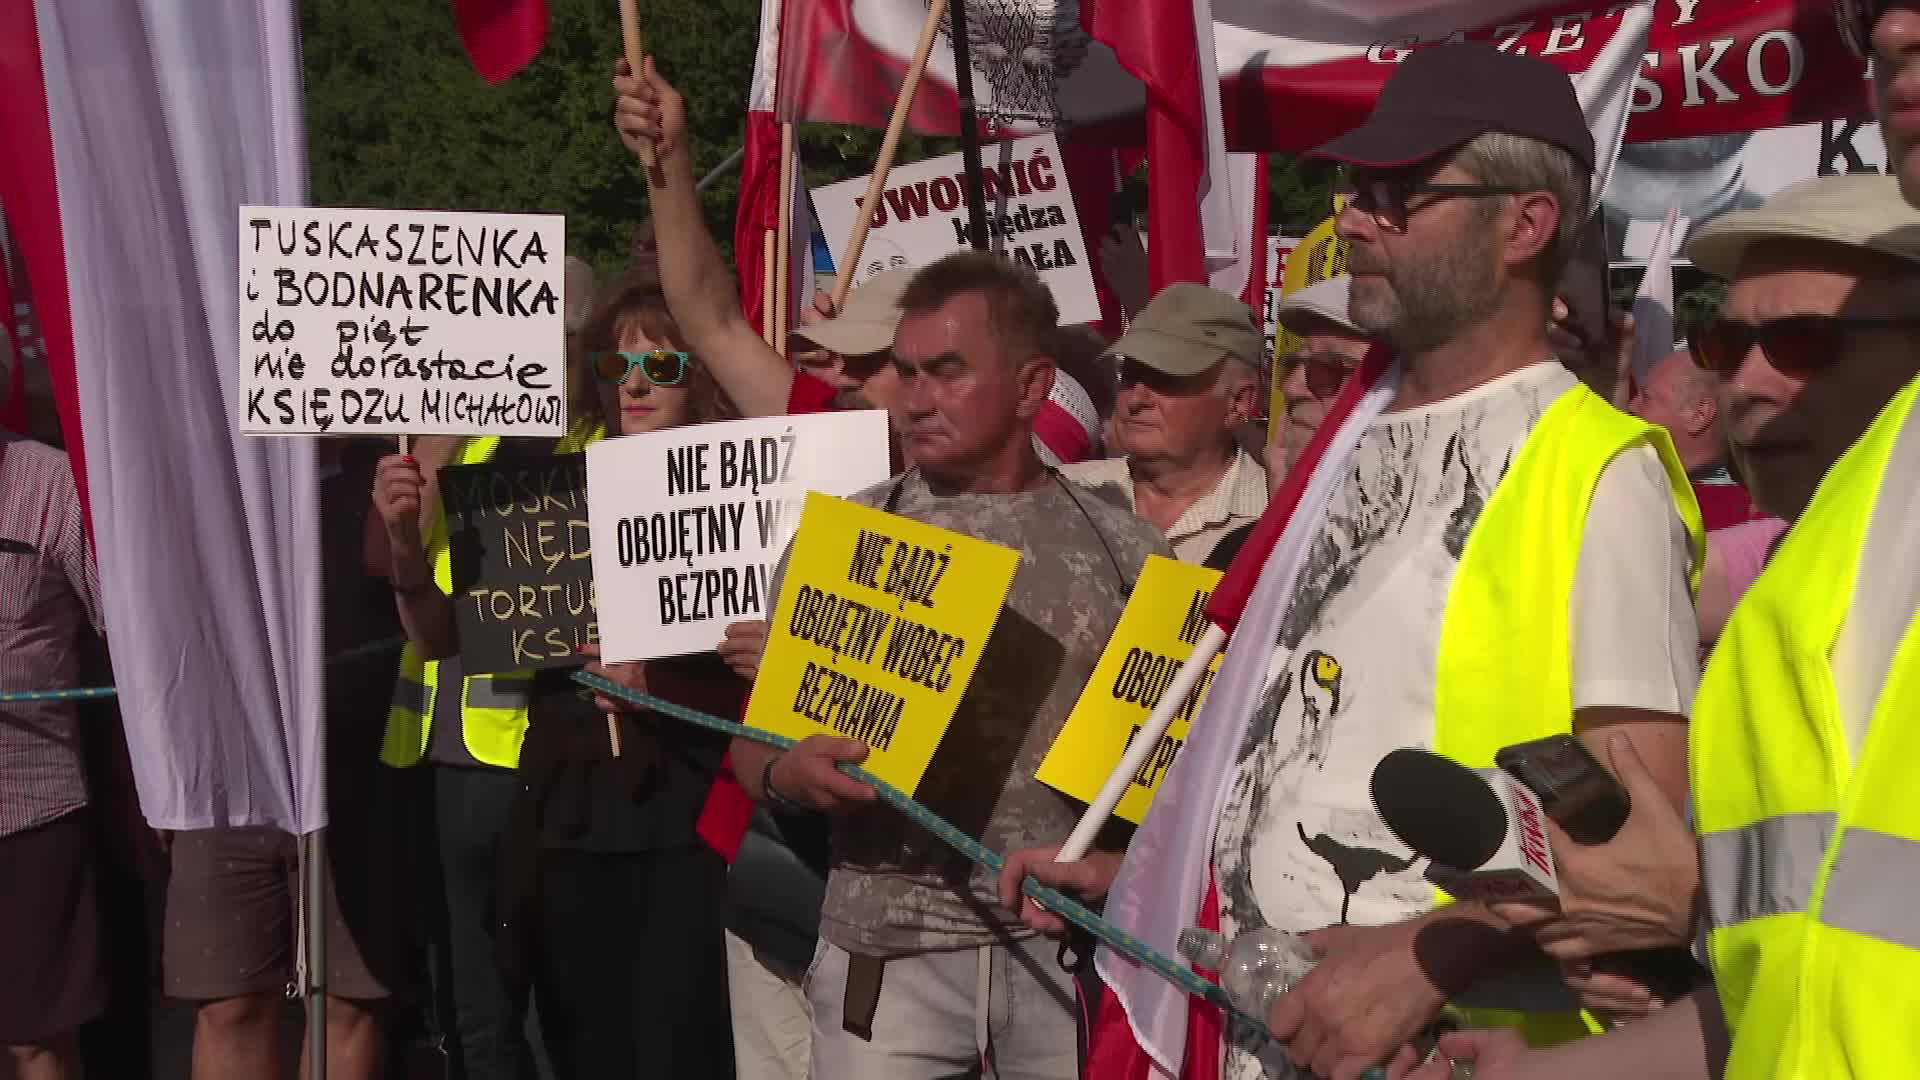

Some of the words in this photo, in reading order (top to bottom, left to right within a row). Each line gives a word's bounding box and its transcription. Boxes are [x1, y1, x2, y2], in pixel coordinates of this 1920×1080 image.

[1631, 30, 1805, 113] SKO
[250, 219, 548, 268] TUSKASZENKA
[247, 269, 259, 301] i
[274, 268, 559, 316] BODNARENKA
[252, 308, 295, 343] do
[336, 315, 429, 352] pięt
[254, 348, 305, 380] nie
[331, 345, 552, 388] dorastacie
[249, 388, 409, 431] KSIĘDZU
[421, 387, 561, 426] MICHAŁOWI
[667, 443, 710, 496] NIE
[720, 425, 796, 496] BĄDŹ
[504, 519, 590, 574] NĘD
[617, 501, 745, 568] OBOJĘTNY
[848, 528, 893, 591] NIE
[883, 540, 953, 613] BĄDŹ
[789, 584, 892, 665] OBOJĘTNY
[881, 615, 966, 693] WOBEC
[792, 661, 906, 752] BEZPRAWIA
